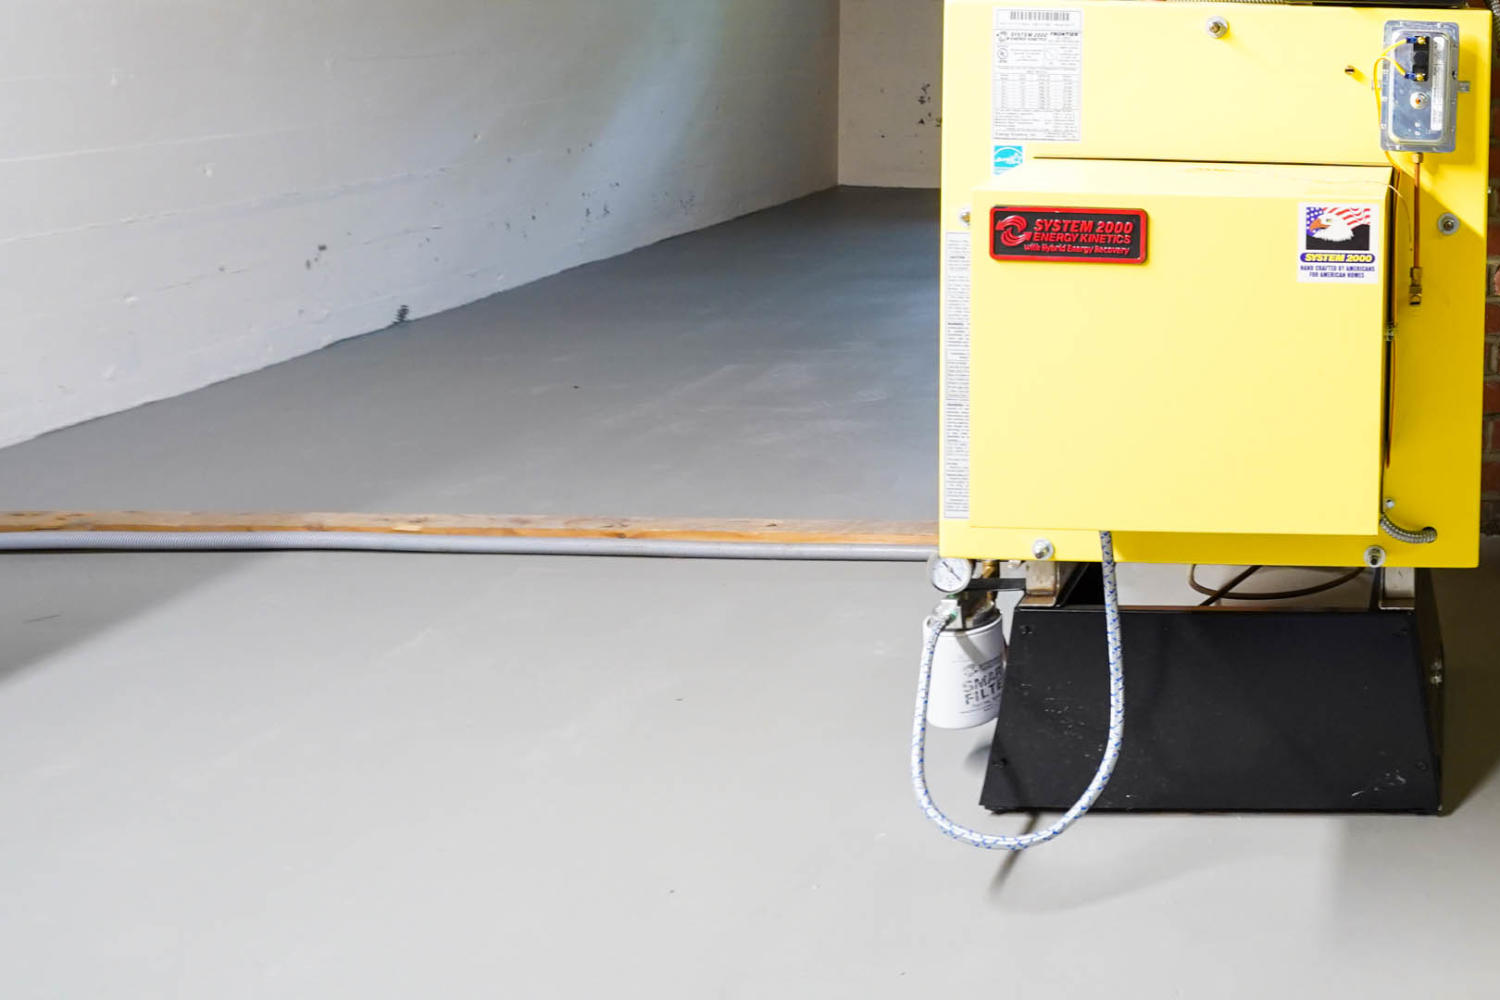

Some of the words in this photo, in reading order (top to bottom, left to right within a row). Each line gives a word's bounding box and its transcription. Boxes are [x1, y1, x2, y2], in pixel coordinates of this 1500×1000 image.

[1034, 219, 1094, 233] SYSTEM
[1096, 221, 1133, 234] 2000
[1033, 233, 1080, 242] ENERGY
[1080, 234, 1131, 244] KINETICS
[1024, 243, 1041, 252] with
[1041, 243, 1066, 254] Hybrid
[1067, 244, 1094, 255] Energy
[1094, 245, 1130, 255] Recovery
[1306, 253, 1345, 262] SYSTEM
[1346, 254, 1372, 262] 2000
[962, 665, 1003, 692] SMAR
